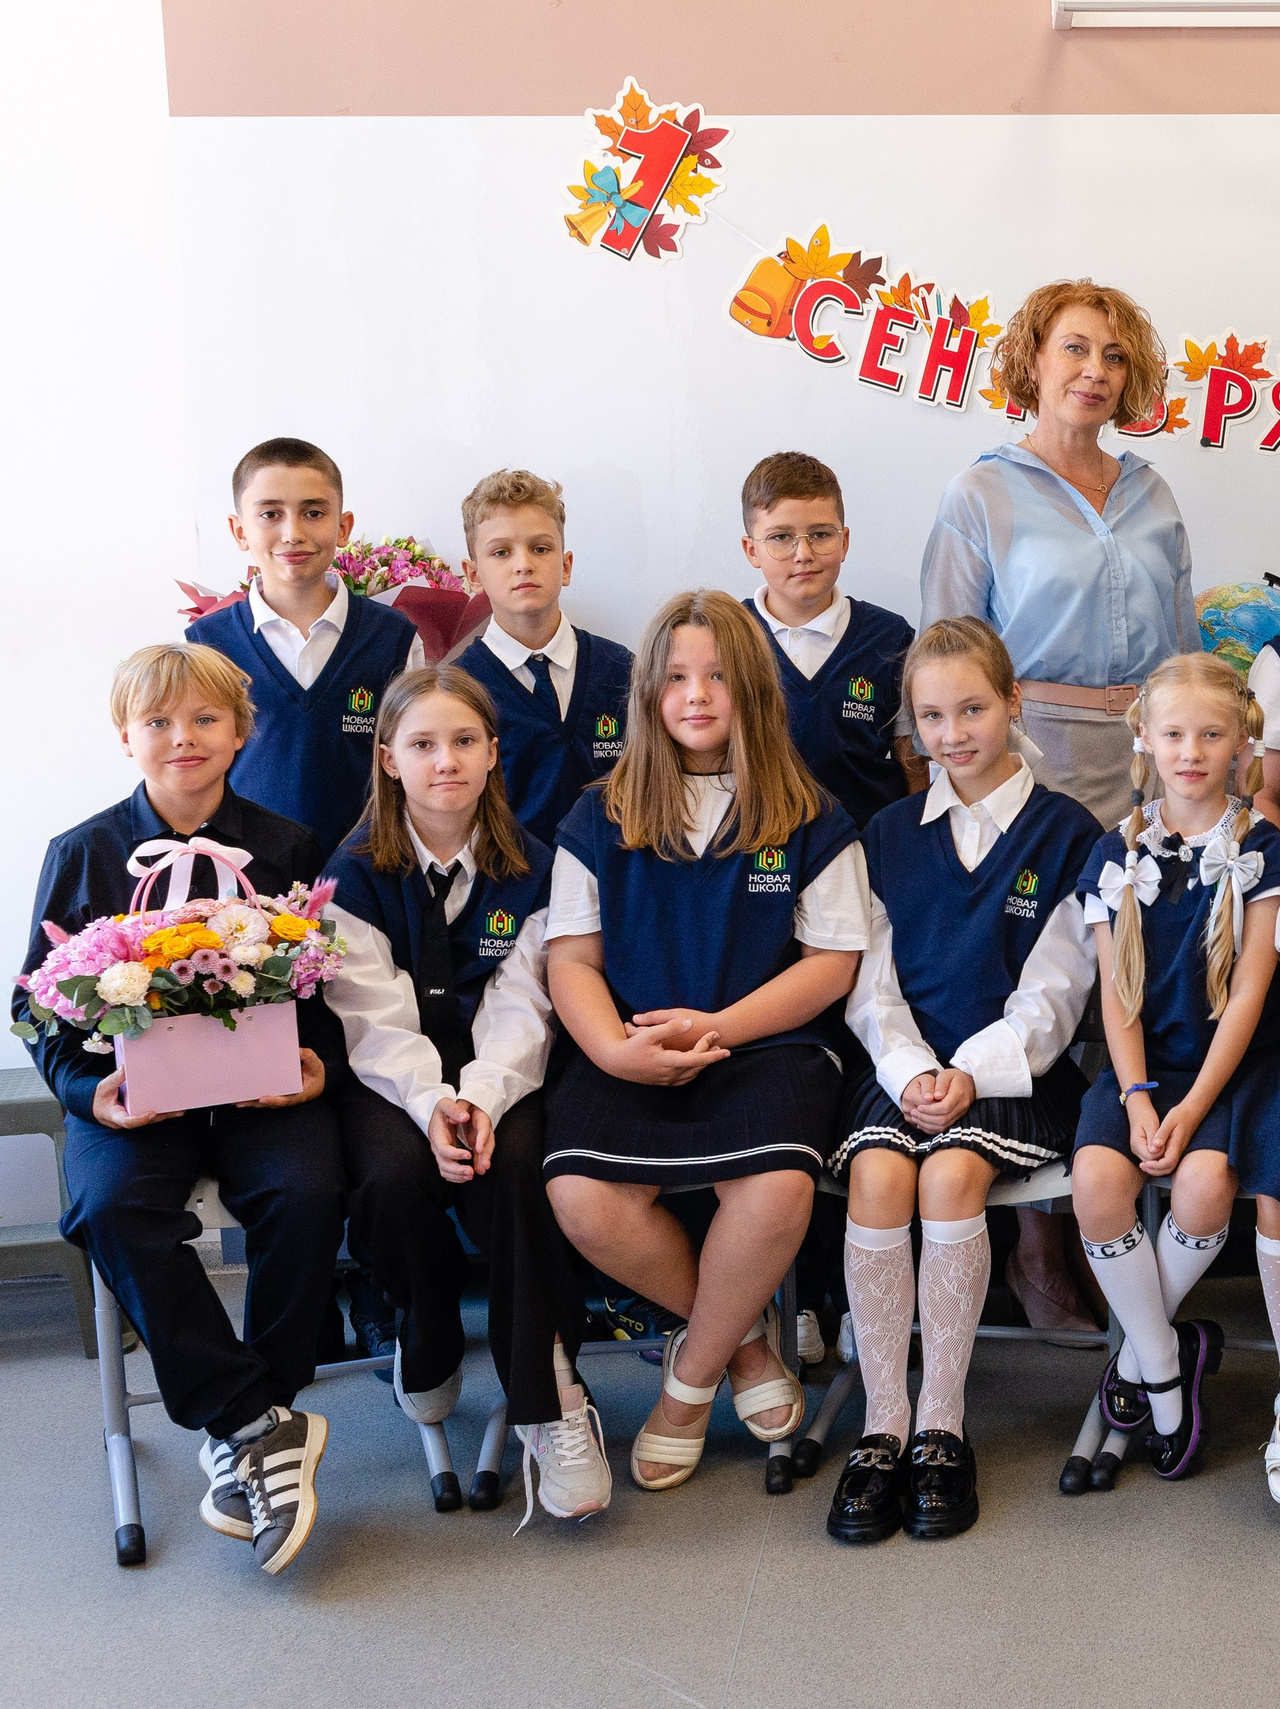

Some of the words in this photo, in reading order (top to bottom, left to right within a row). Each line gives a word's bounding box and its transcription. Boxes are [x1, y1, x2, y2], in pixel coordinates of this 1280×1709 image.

[600, 118, 693, 262] 1
[842, 700, 876, 714] НОВАЯ
[342, 714, 376, 725] НОВАЯ
[842, 709, 874, 722] ШКОЛА
[342, 723, 374, 734] ШКОЛА
[592, 741, 624, 750] НОВАЯ
[748, 873, 791, 883] НОВАЯ
[748, 883, 791, 892] ШКОЛА
[1006, 895, 1038, 909] НОВАЯ
